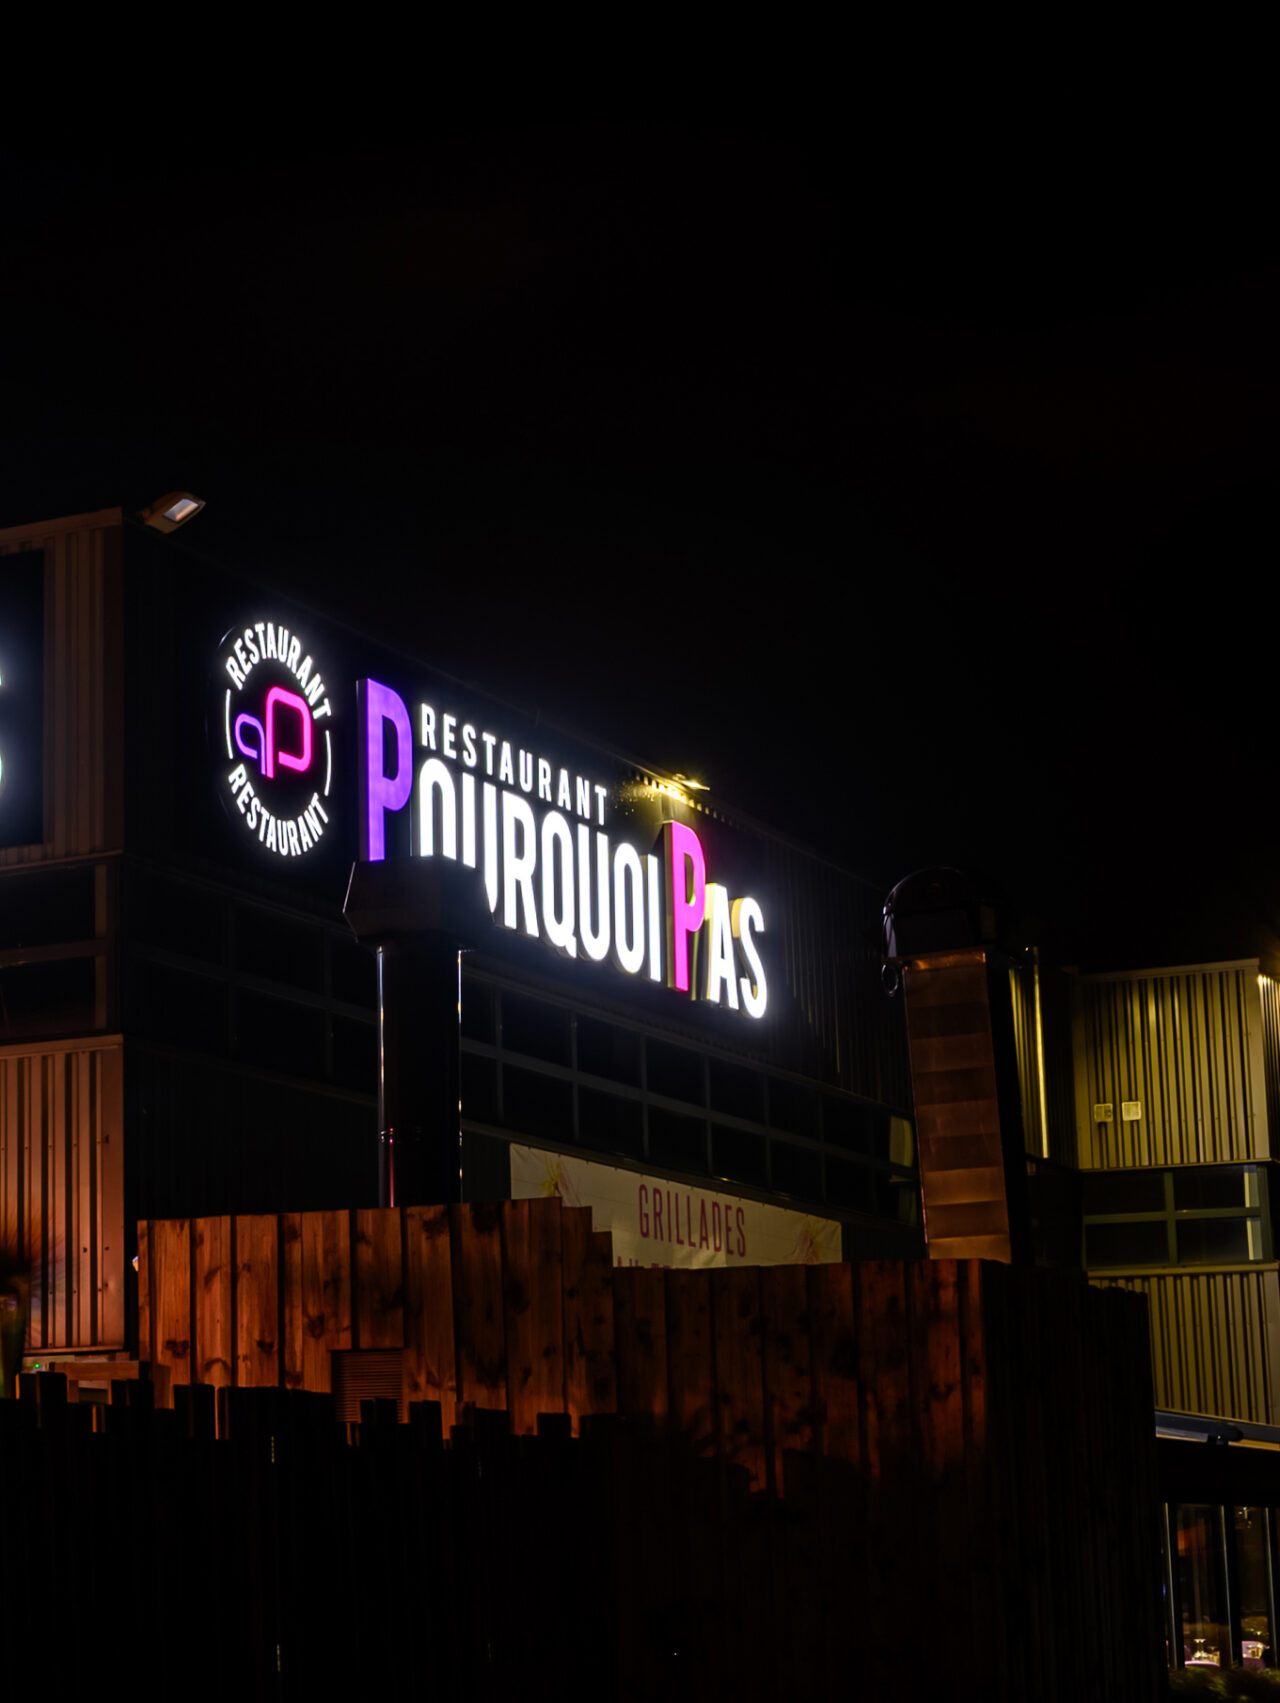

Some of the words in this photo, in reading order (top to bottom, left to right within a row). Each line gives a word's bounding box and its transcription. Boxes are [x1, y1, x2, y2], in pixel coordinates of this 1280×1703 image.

[225, 621, 332, 720] RESTAURANT
[228, 763, 329, 857] RESTAURANT
[420, 702, 608, 826] RESTAURANT
[670, 819, 769, 1020] PAS
[638, 1184, 746, 1258] GRILLADES
